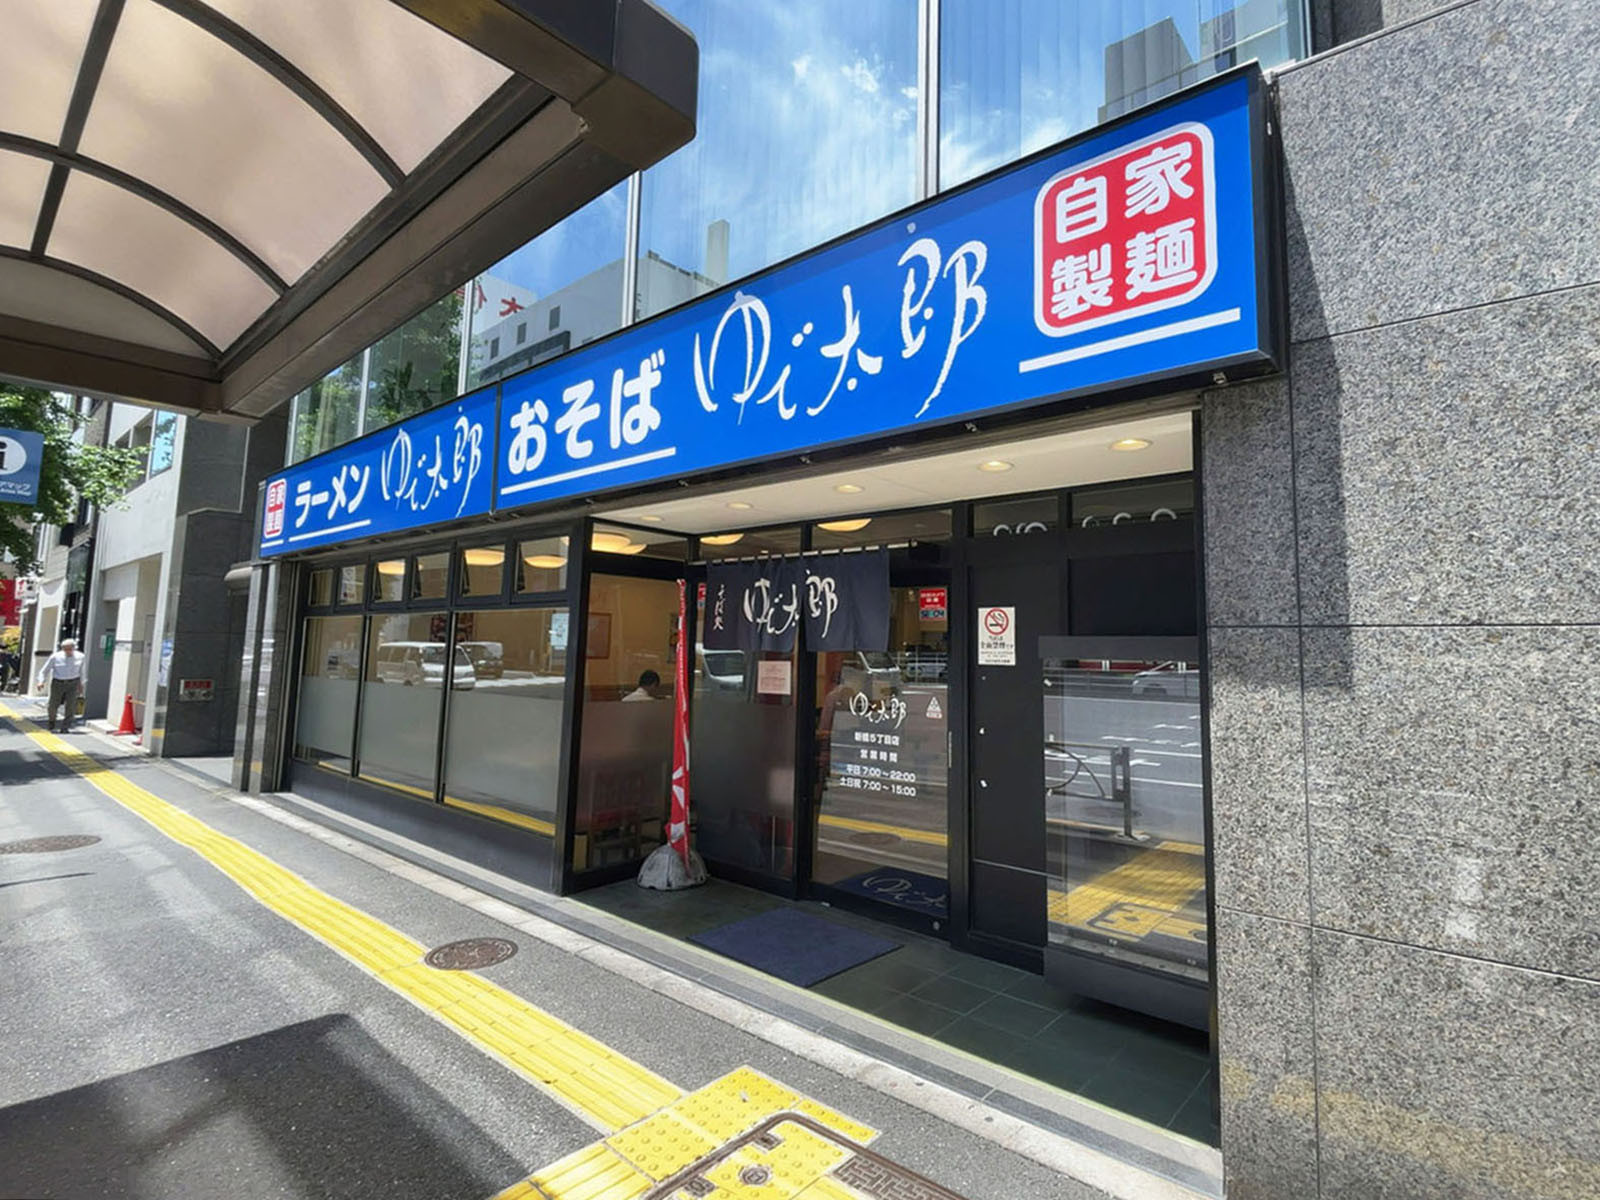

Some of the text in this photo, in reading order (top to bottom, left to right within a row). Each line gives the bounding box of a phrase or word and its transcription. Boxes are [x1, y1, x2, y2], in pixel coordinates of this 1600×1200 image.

[1053, 140, 1196, 245] 自家
[1050, 217, 1199, 322] 製麺
[508, 222, 988, 475] おそば ゆで太郎
[295, 406, 484, 528] ラーメン ゆで太郎
[743, 569, 838, 638] ゆで太郎
[849, 692, 906, 729] ゆで太郎
